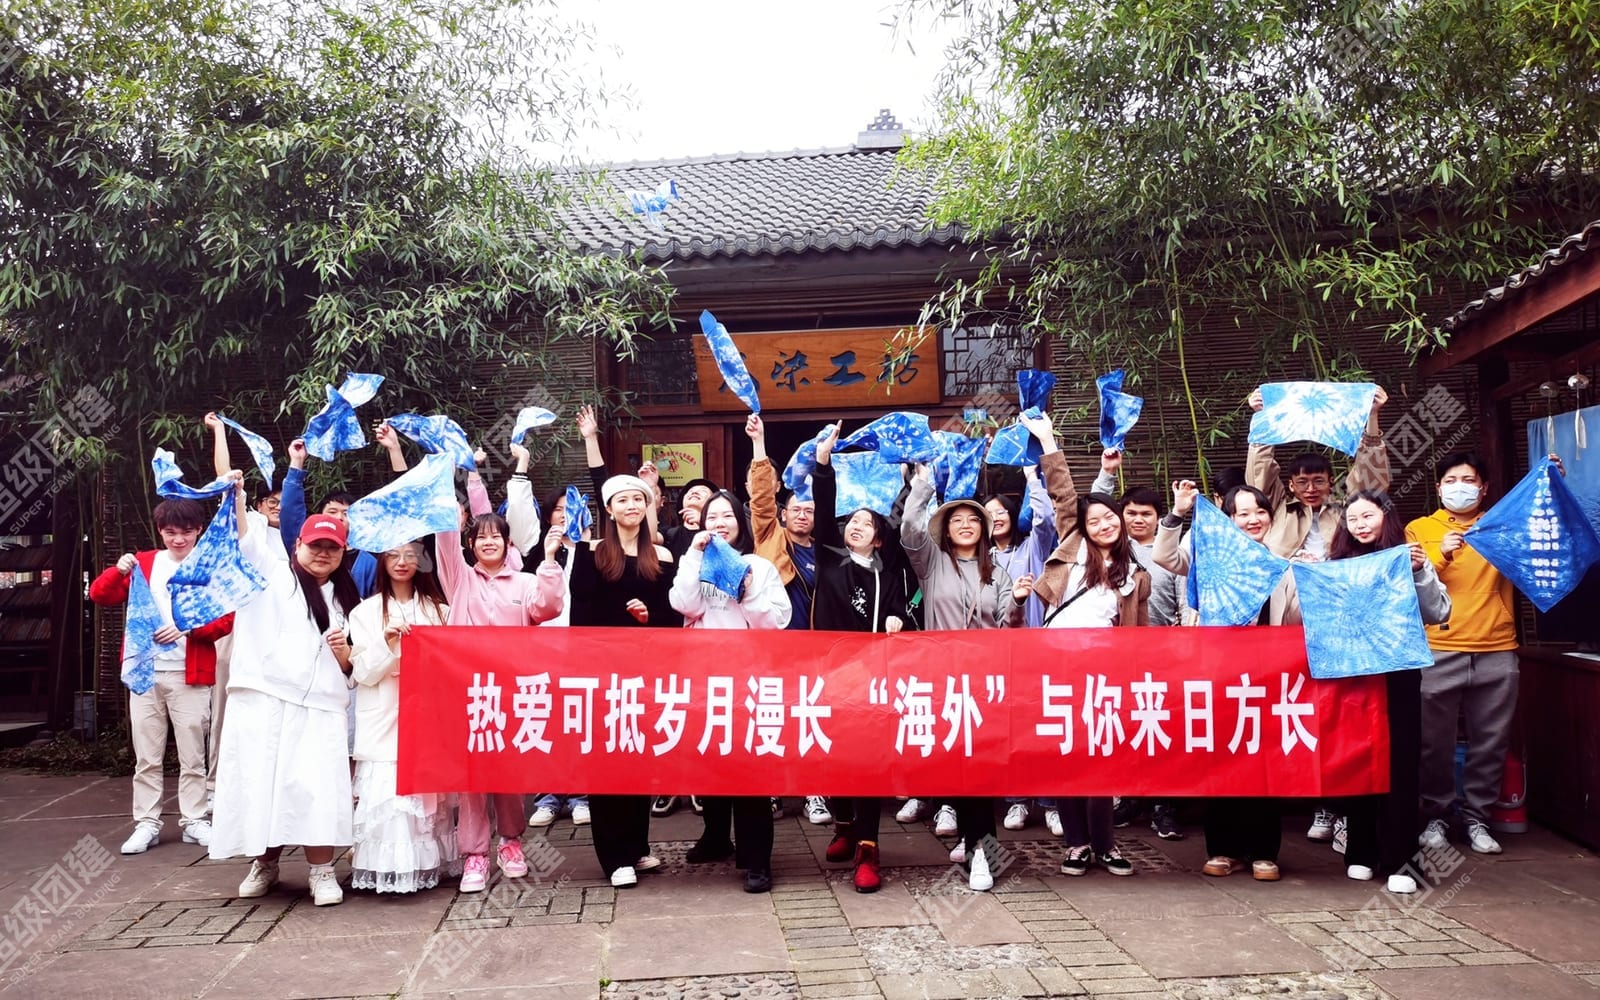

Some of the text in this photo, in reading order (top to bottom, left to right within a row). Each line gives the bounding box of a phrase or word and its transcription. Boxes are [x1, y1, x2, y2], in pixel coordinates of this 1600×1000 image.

[718, 350, 919, 393] 染工坊
[467, 671, 1319, 758] 热爱可抵岁月漫长 “海外” 与你来日方长
